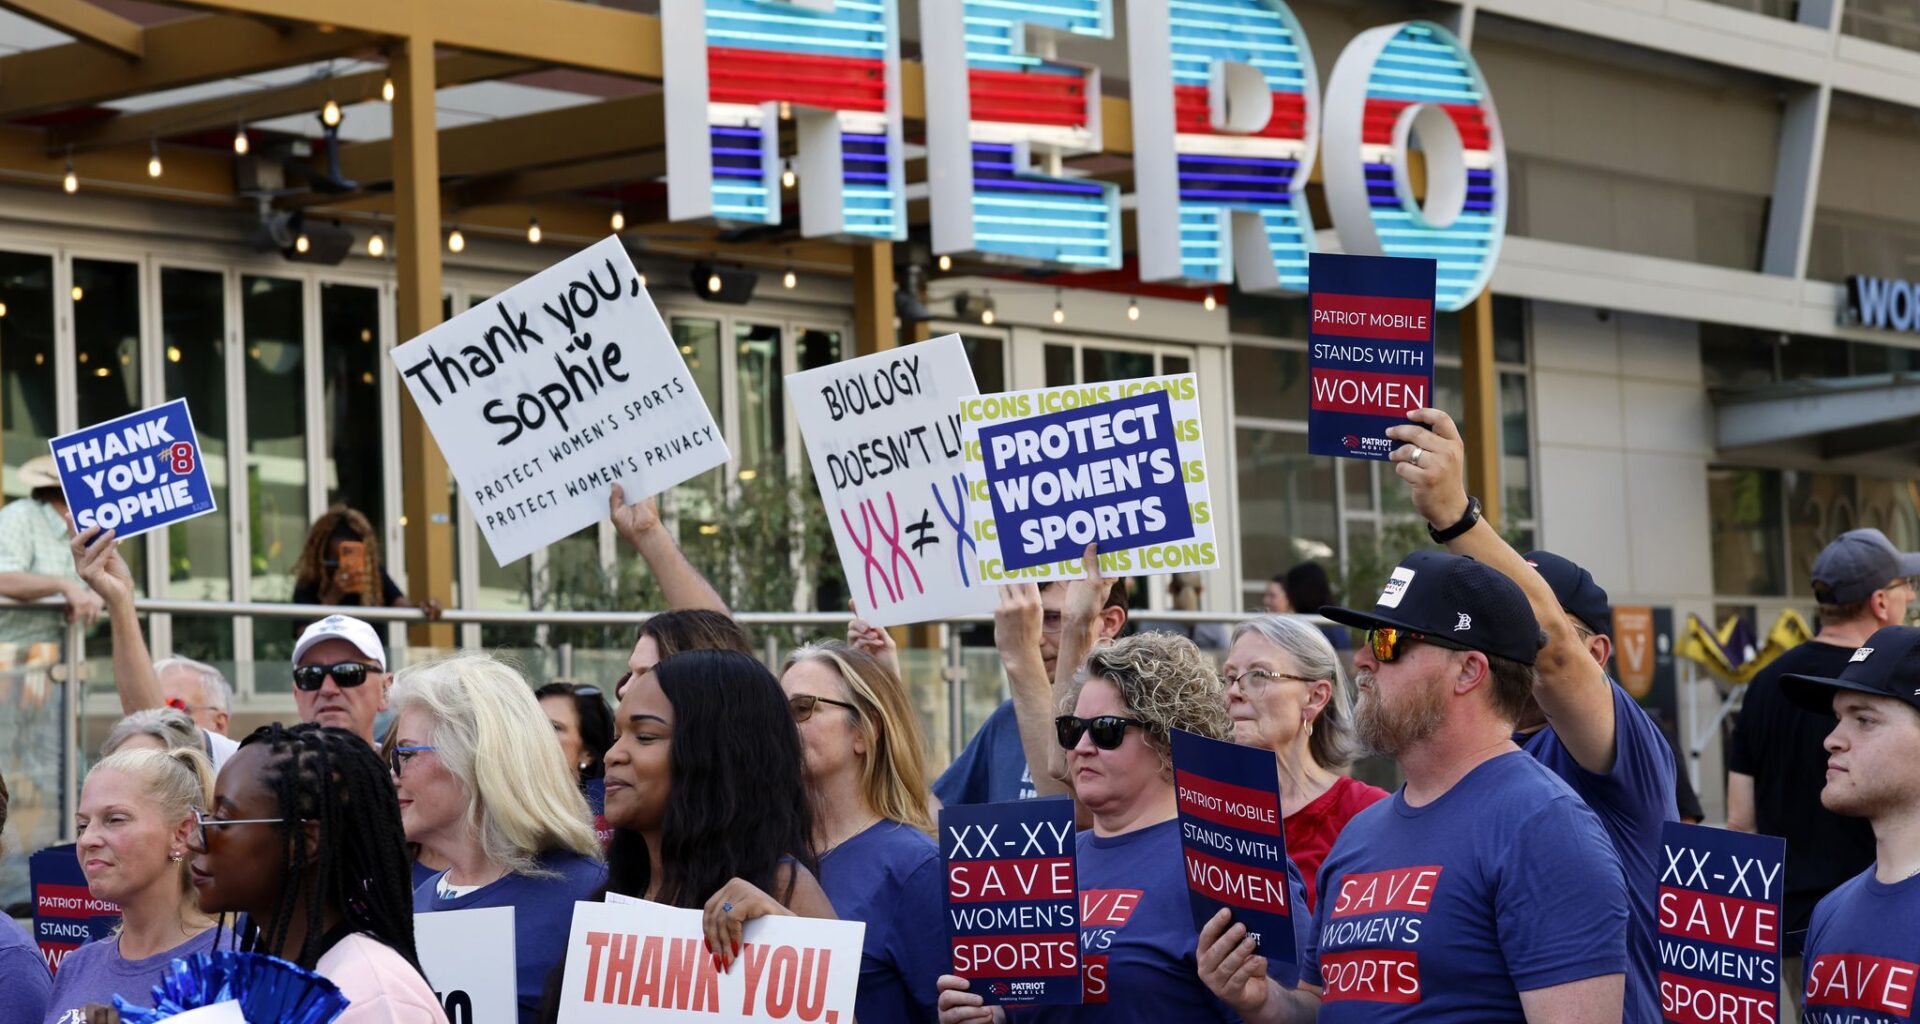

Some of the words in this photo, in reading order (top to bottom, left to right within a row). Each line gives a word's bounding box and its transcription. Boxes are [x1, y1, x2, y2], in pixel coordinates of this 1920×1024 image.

[660, 0, 1507, 311] HERO
[404, 301, 544, 406] Thank
[542, 258, 640, 350] you,
[1314, 309, 1367, 326] PATRIOT
[1370, 313, 1427, 330] MOBILE
[1314, 343, 1374, 363] STANDS
[1378, 348, 1424, 367] WITH
[483, 334, 629, 446] Sophie
[821, 354, 923, 422] BIOLOGY
[960, 394, 1032, 423] ICONS
[1038, 385, 1111, 415] ICONS
[1313, 376, 1424, 410] WOMEN
[57, 416, 175, 473] THANK
[157, 440, 195, 476] #8
[474, 457, 544, 506] PROTECT
[548, 413, 619, 463] WOMEN'S
[624, 377, 685, 421] SPORTS
[826, 425, 931, 492] DOESN'T
[936, 413, 962, 459] LI
[991, 403, 1160, 470] PROTECT
[1361, 437, 1393, 447] PATRIOT
[82, 454, 169, 499] YOU,
[486, 490, 558, 531] PROTECT
[564, 456, 638, 498] WOMEN'S
[644, 425, 714, 467] PRIVACY
[994, 448, 1176, 514] WOMEN'S
[77, 479, 194, 532] SOPHIE
[1020, 496, 1167, 555] SPORTS
[1138, 542, 1216, 569] ICONS
[1180, 786, 1223, 812] PATRIOT
[1225, 801, 1276, 824] MOBILE
[949, 820, 1073, 860] XX-XY
[1183, 822, 1233, 852] STANDS
[1235, 838, 1279, 861] WITH
[950, 862, 1073, 898] SAVE
[1186, 856, 1285, 907] WOMEN
[1334, 871, 1437, 912] SAVE
[1660, 844, 1782, 900] XX-XY
[39, 896, 83, 910] PATRIOT
[85, 899, 122, 913] MOBIL
[950, 905, 1074, 931] WOMEN'S
[1659, 892, 1776, 947] SAVE
[40, 922, 90, 938] STANDS
[1322, 916, 1422, 947] WOMEN'S
[583, 931, 720, 1014] THANK
[742, 942, 839, 1024] YOU,
[953, 941, 1078, 972] SPORTS
[1321, 960, 1419, 996] SPORTS
[1659, 939, 1775, 985] WOMEN'S
[1011, 981, 1045, 991] PATRIOT
[1660, 981, 1776, 1024] SPORTS
[1806, 959, 1914, 1010] SAVE
